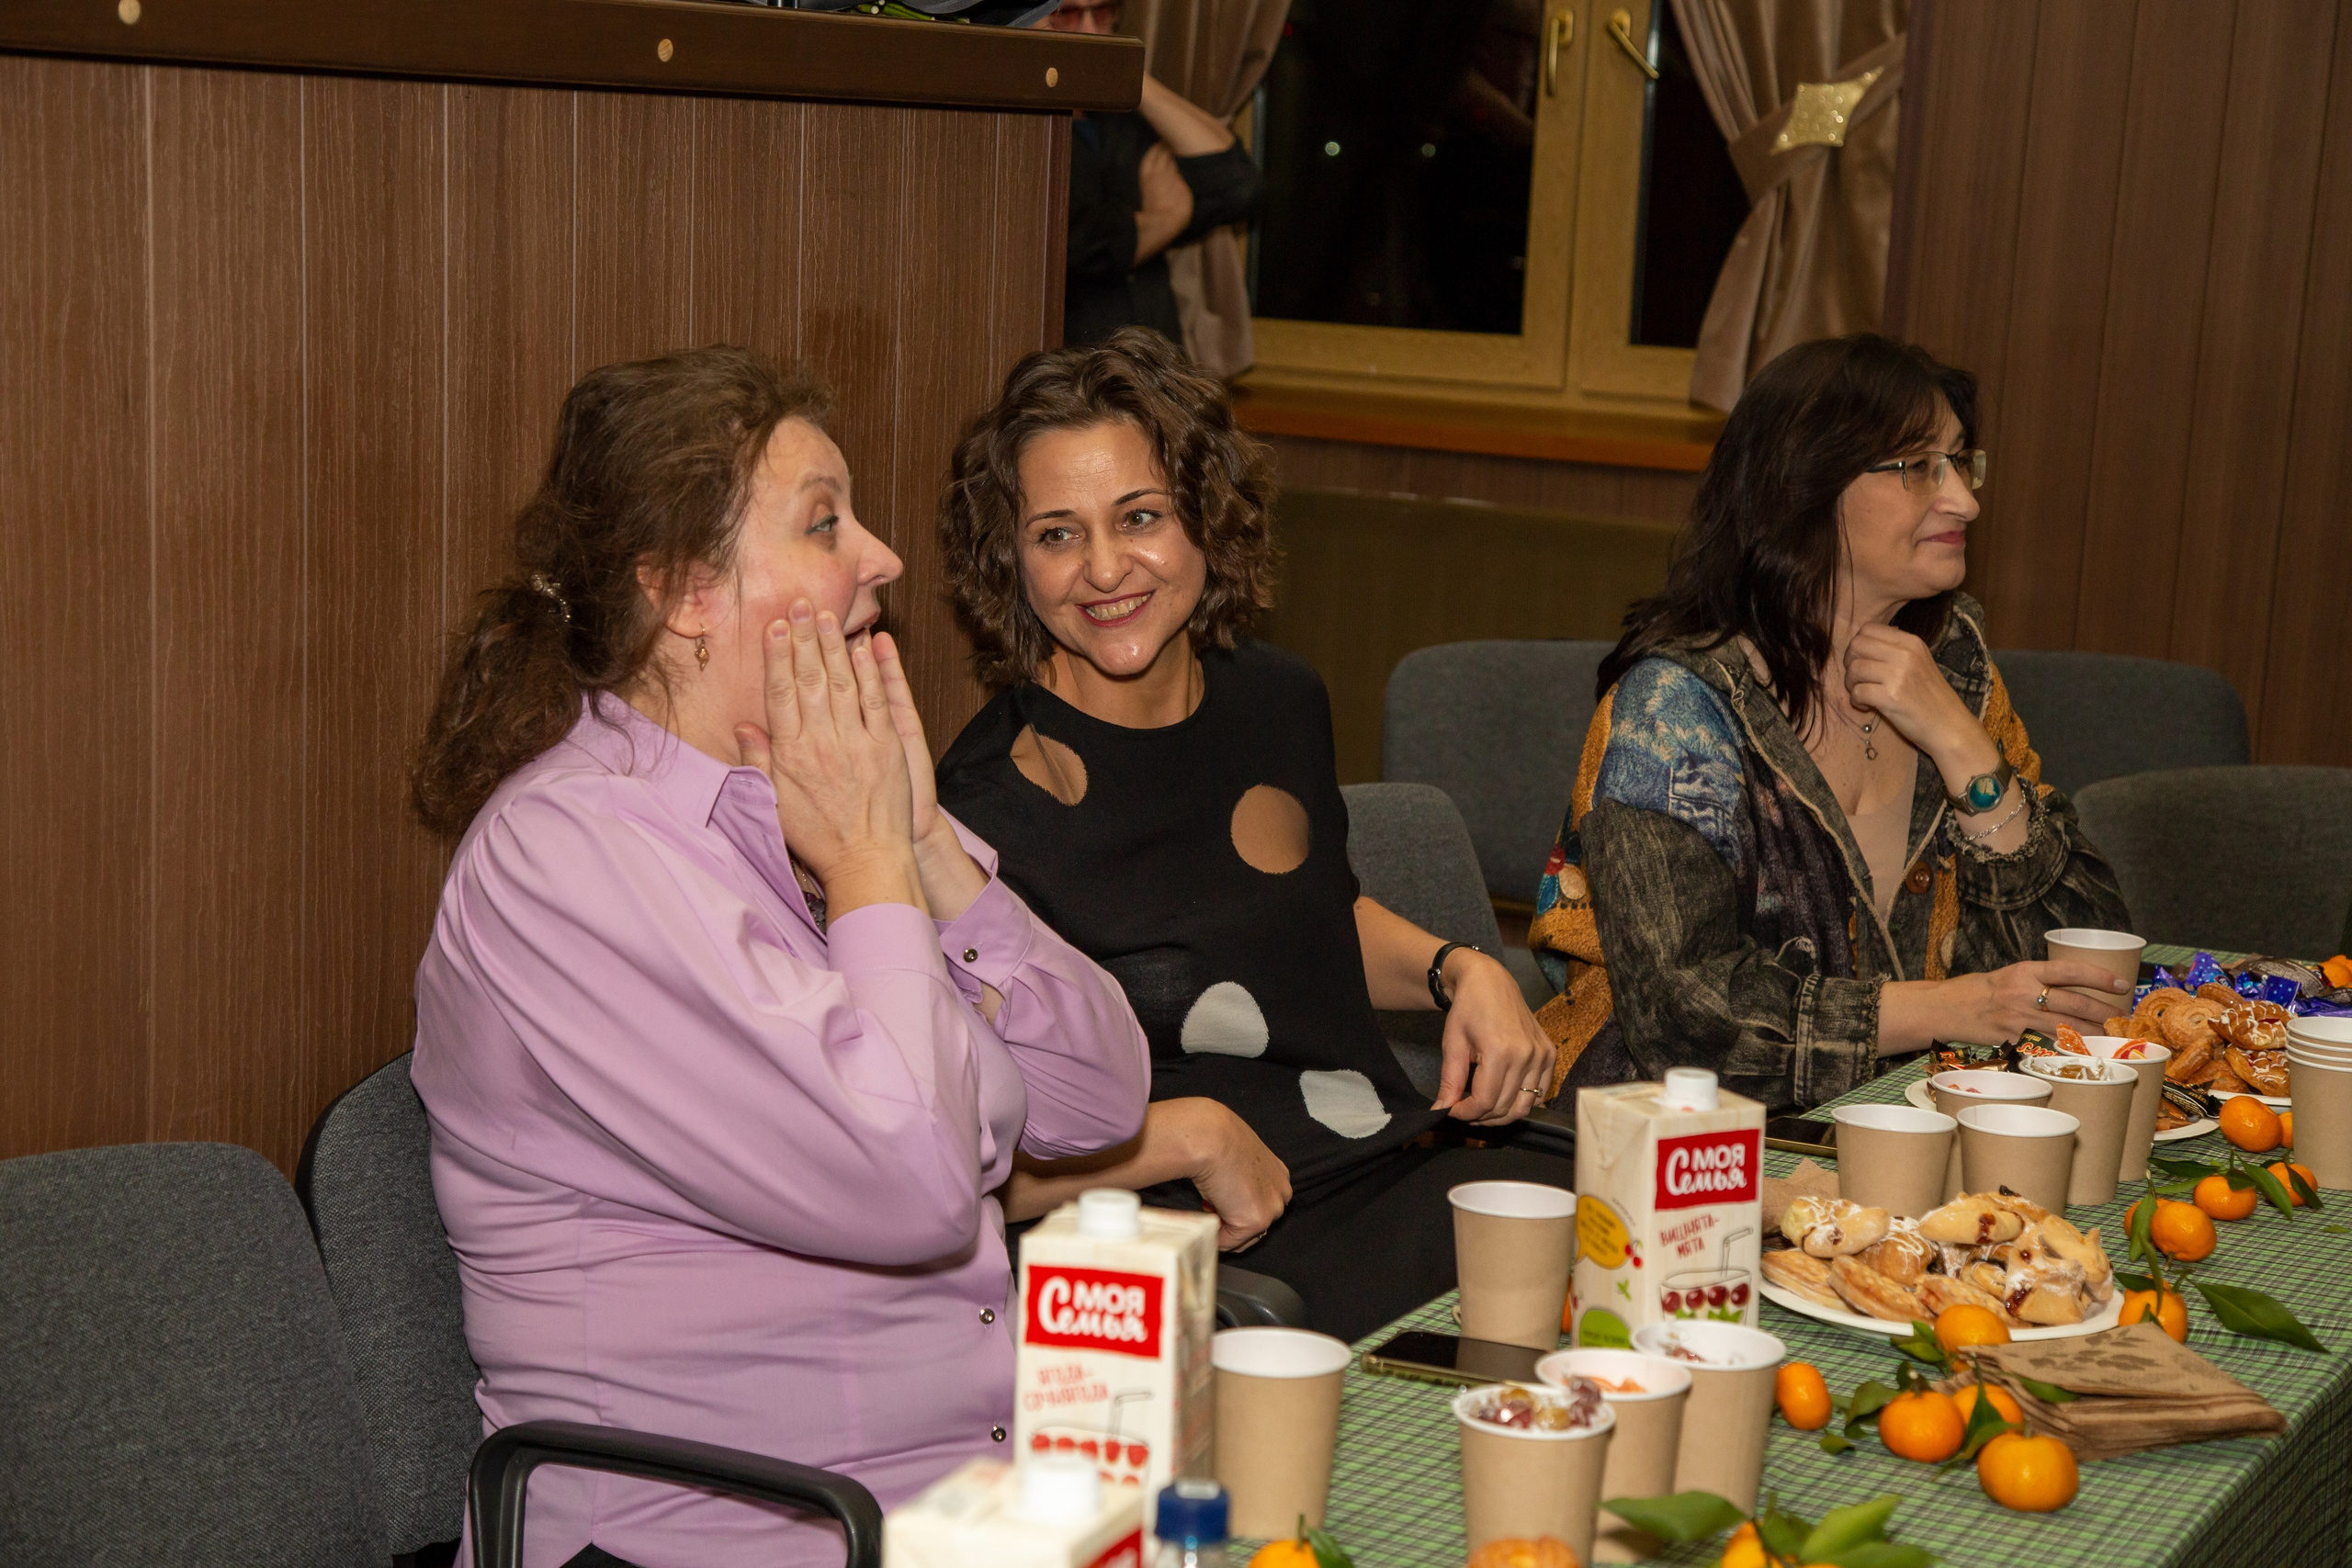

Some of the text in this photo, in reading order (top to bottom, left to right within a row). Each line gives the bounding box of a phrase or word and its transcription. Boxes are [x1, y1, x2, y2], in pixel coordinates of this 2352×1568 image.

[2016, 1042, 2058, 1057] ars
[1666, 1146, 1747, 1195] Семья
[1690, 1143, 1747, 1171] МОЯ
[1677, 1237, 1706, 1258] МЯТА
[1038, 1276, 1148, 1342] Семья
[1073, 1280, 1146, 1315] МОЯ
